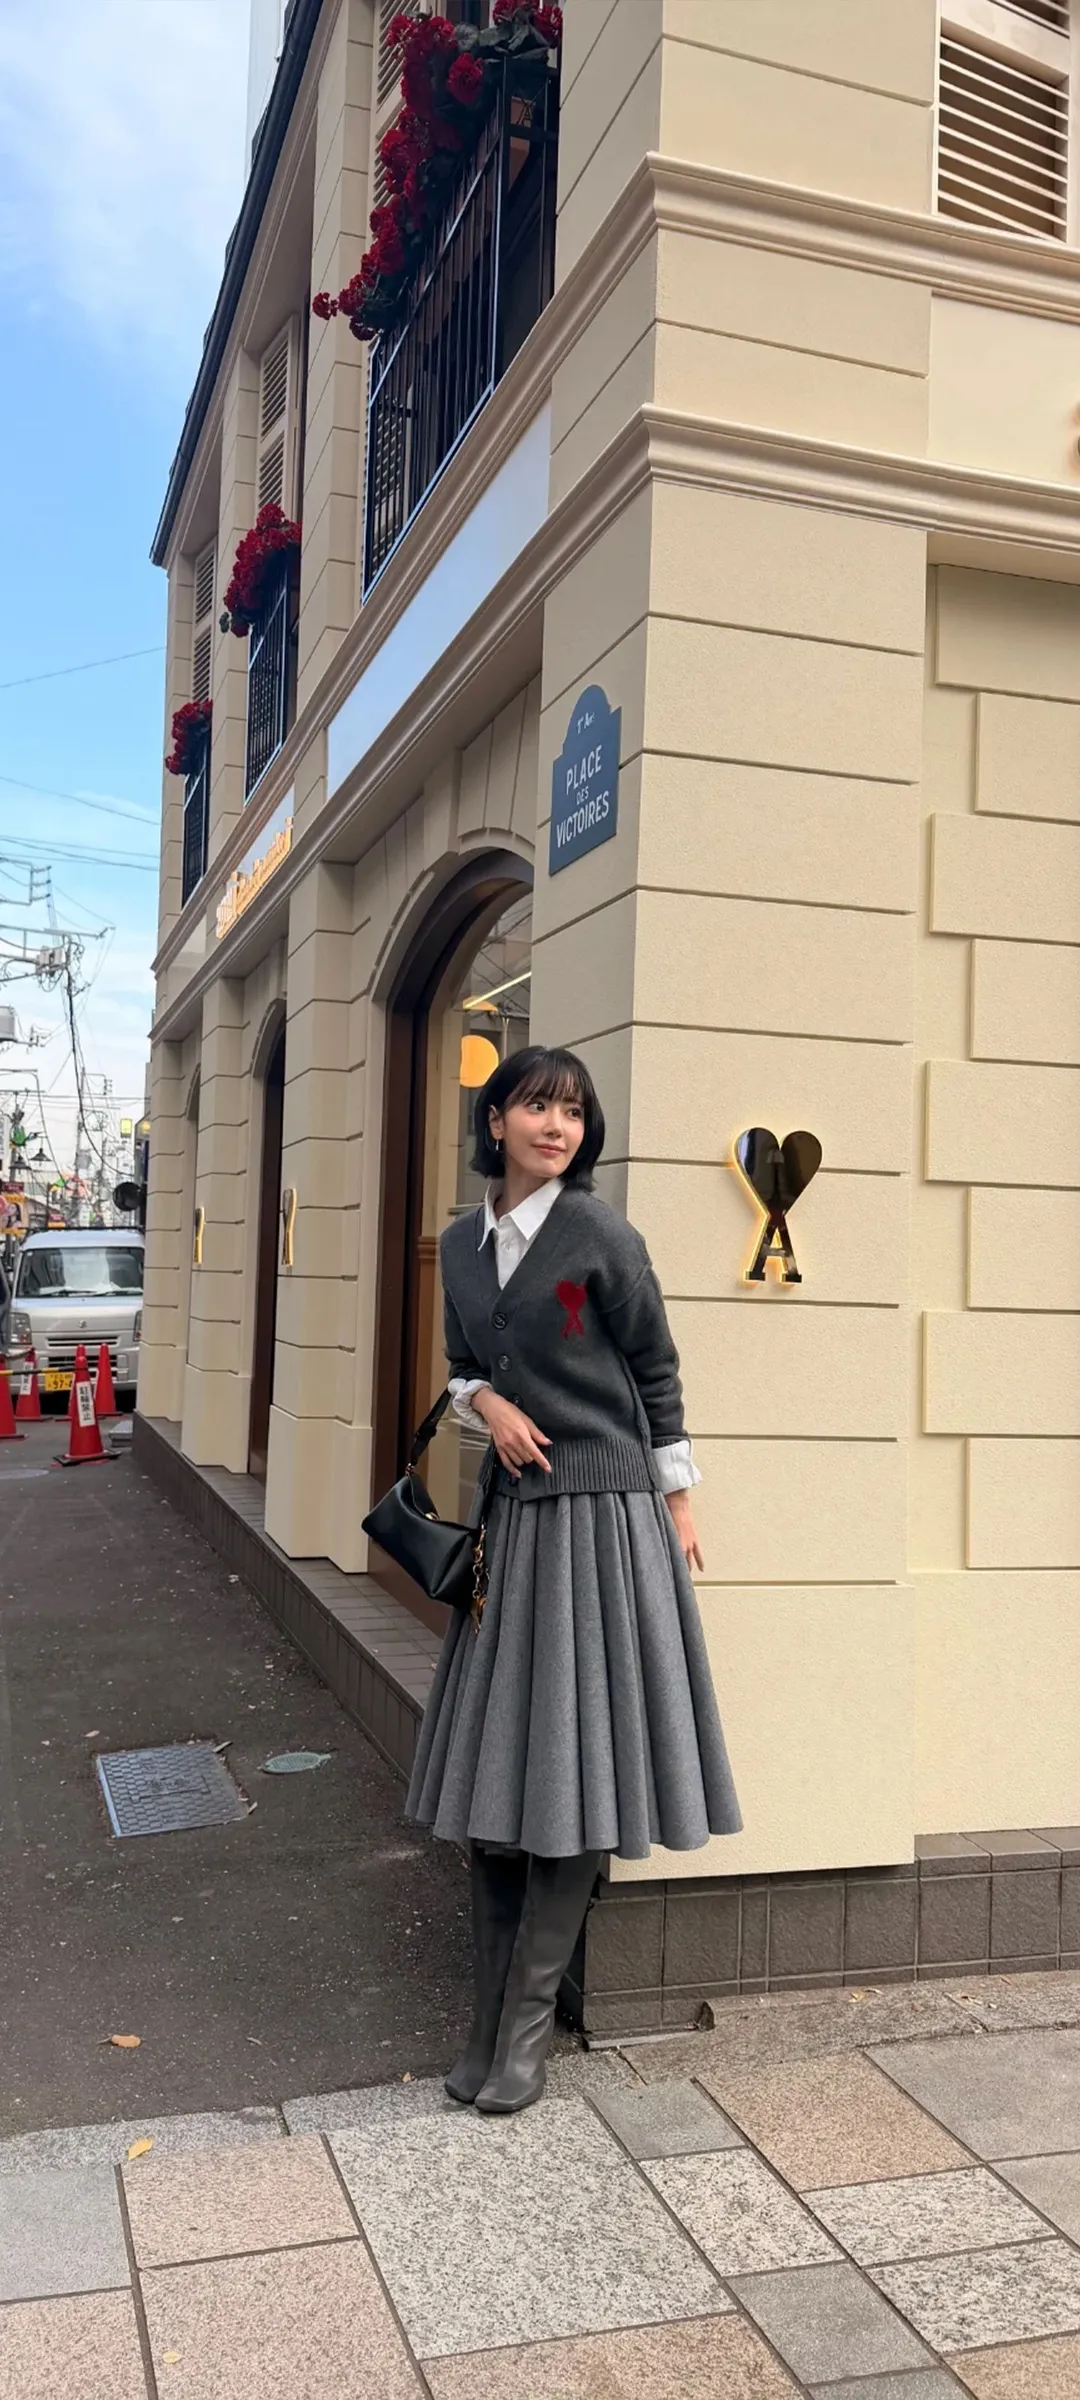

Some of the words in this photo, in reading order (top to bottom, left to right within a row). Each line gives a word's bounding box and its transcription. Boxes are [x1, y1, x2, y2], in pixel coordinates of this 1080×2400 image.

[566, 745, 602, 795] PLACE
[556, 790, 610, 848] VICTOIRES
[576, 786, 589, 805] DES
